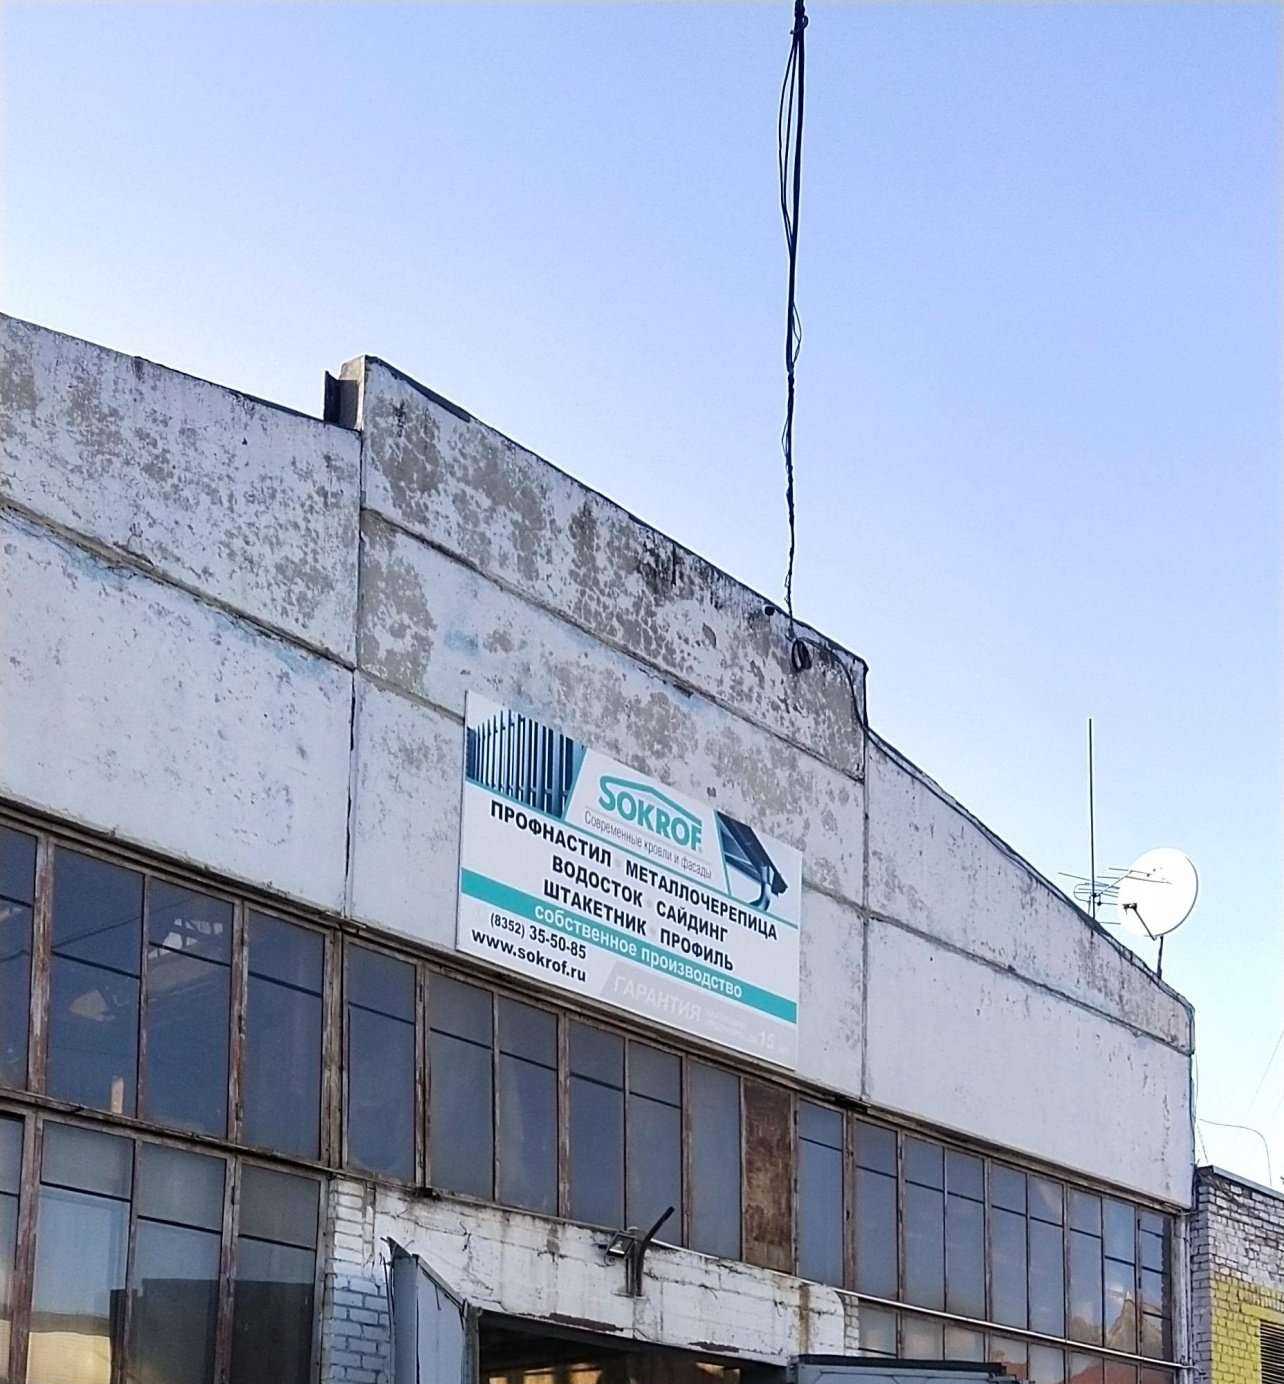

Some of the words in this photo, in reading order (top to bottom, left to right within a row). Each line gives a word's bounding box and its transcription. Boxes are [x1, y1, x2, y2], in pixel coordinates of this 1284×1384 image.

[584, 809, 642, 849] Современные
[643, 838, 672, 864] кровли
[673, 852, 681, 865] и
[681, 853, 712, 880] фасады
[598, 775, 703, 852] SOKROF
[490, 799, 612, 867] ПРОФНАСТИЛ
[626, 860, 778, 941] МЕТАЛЛОЧЕРЕПИЦА
[552, 855, 643, 908] ВОДОСТОК
[656, 901, 728, 943] САЙДИНГ
[471, 928, 586, 983] www.sokrof.ru
[490, 912, 526, 939] (8352)
[529, 925, 587, 960] 35-50-85
[534, 905, 638, 957] собственное
[641, 948, 743, 999] производство
[543, 878, 647, 936] ШТАКЕТНИК
[660, 928, 734, 971] ПРОФИЛЬ
[613, 975, 702, 1022] ГАРАНТИЯ
